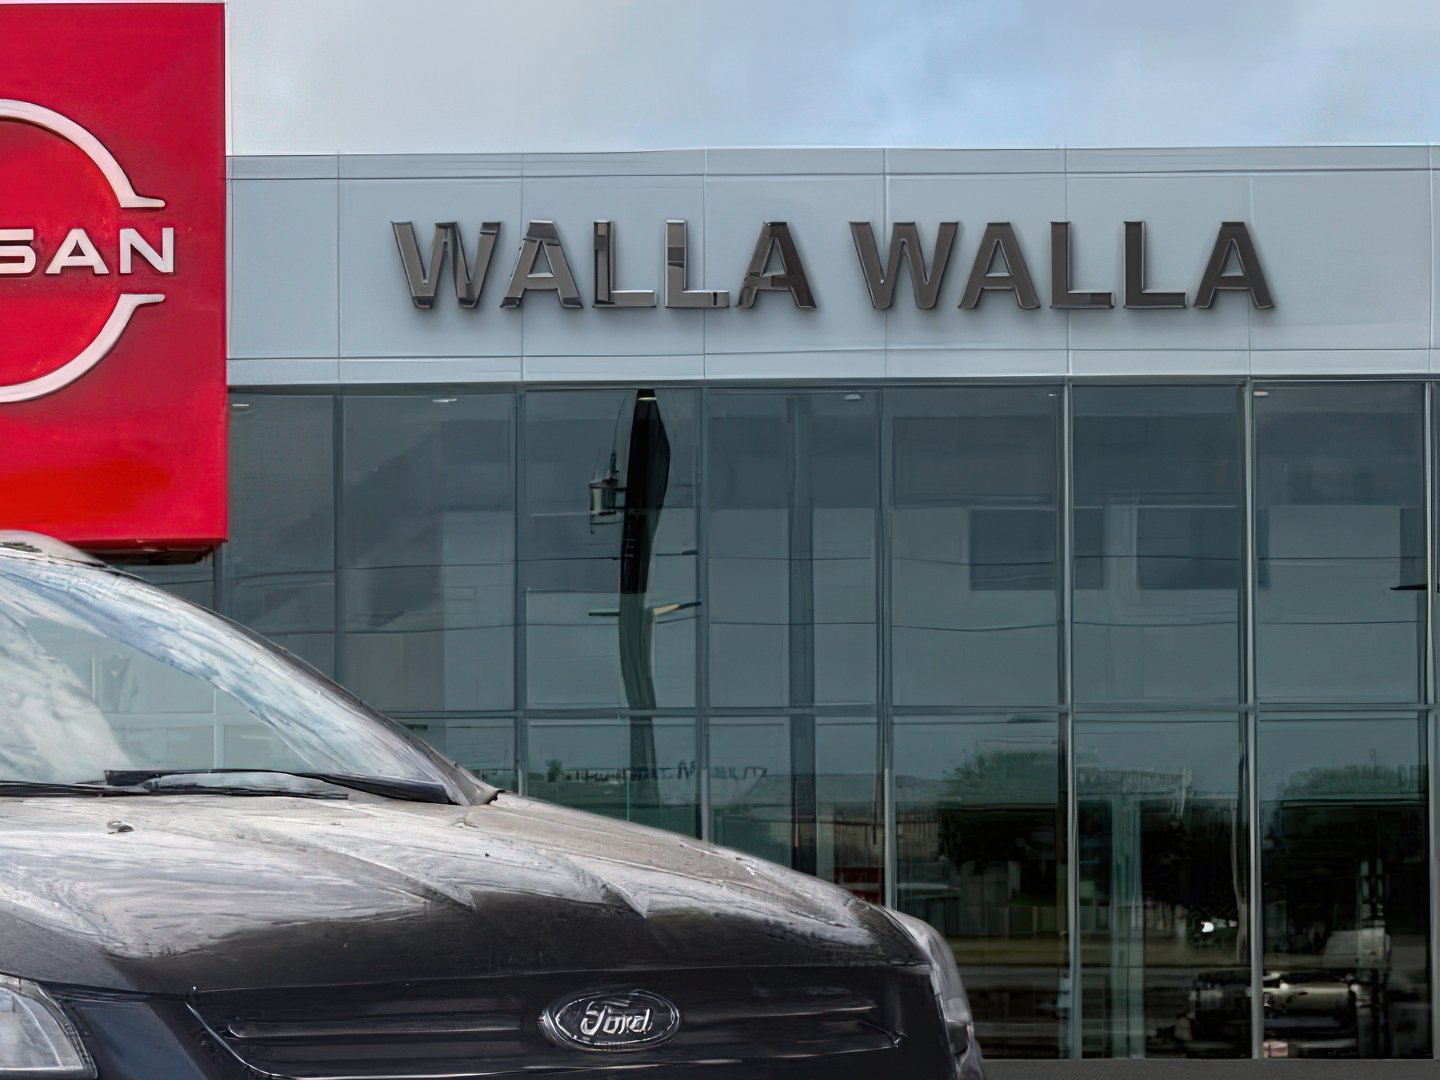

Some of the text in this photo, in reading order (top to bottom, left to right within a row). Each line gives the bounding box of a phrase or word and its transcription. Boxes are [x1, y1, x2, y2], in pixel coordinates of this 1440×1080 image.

[390, 219, 1276, 311] WALLA WALLA
[579, 1000, 654, 1036] Ford
